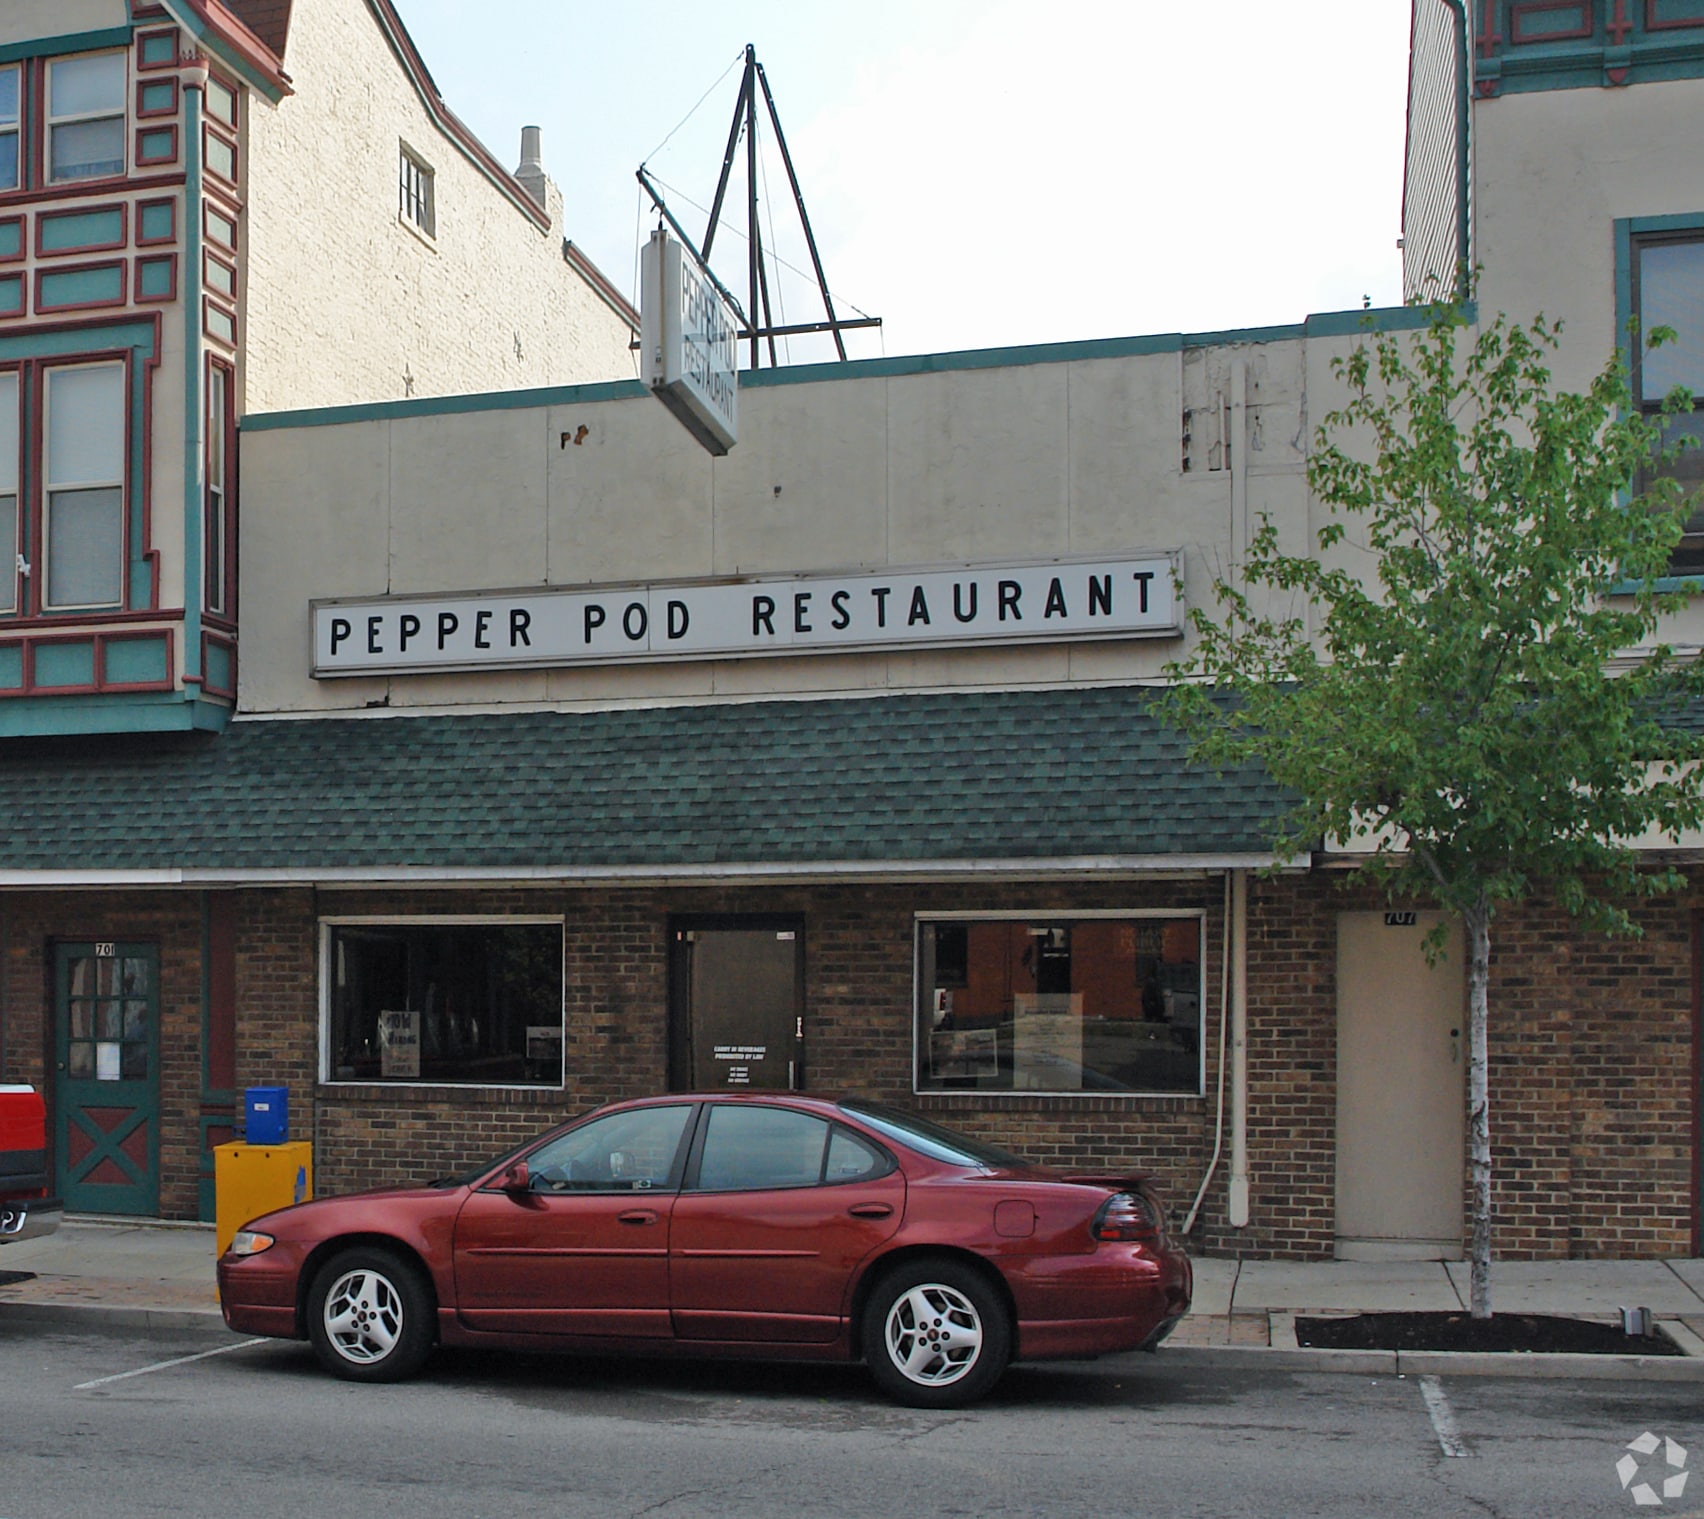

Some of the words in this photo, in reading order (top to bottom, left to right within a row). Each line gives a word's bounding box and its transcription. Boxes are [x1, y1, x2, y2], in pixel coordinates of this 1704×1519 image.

[684, 334, 734, 424] RESTAURANT
[330, 608, 531, 656] PEPPER
[584, 600, 690, 644] POD
[752, 571, 1155, 636] RESTAURANT
[98, 944, 114, 955] 701
